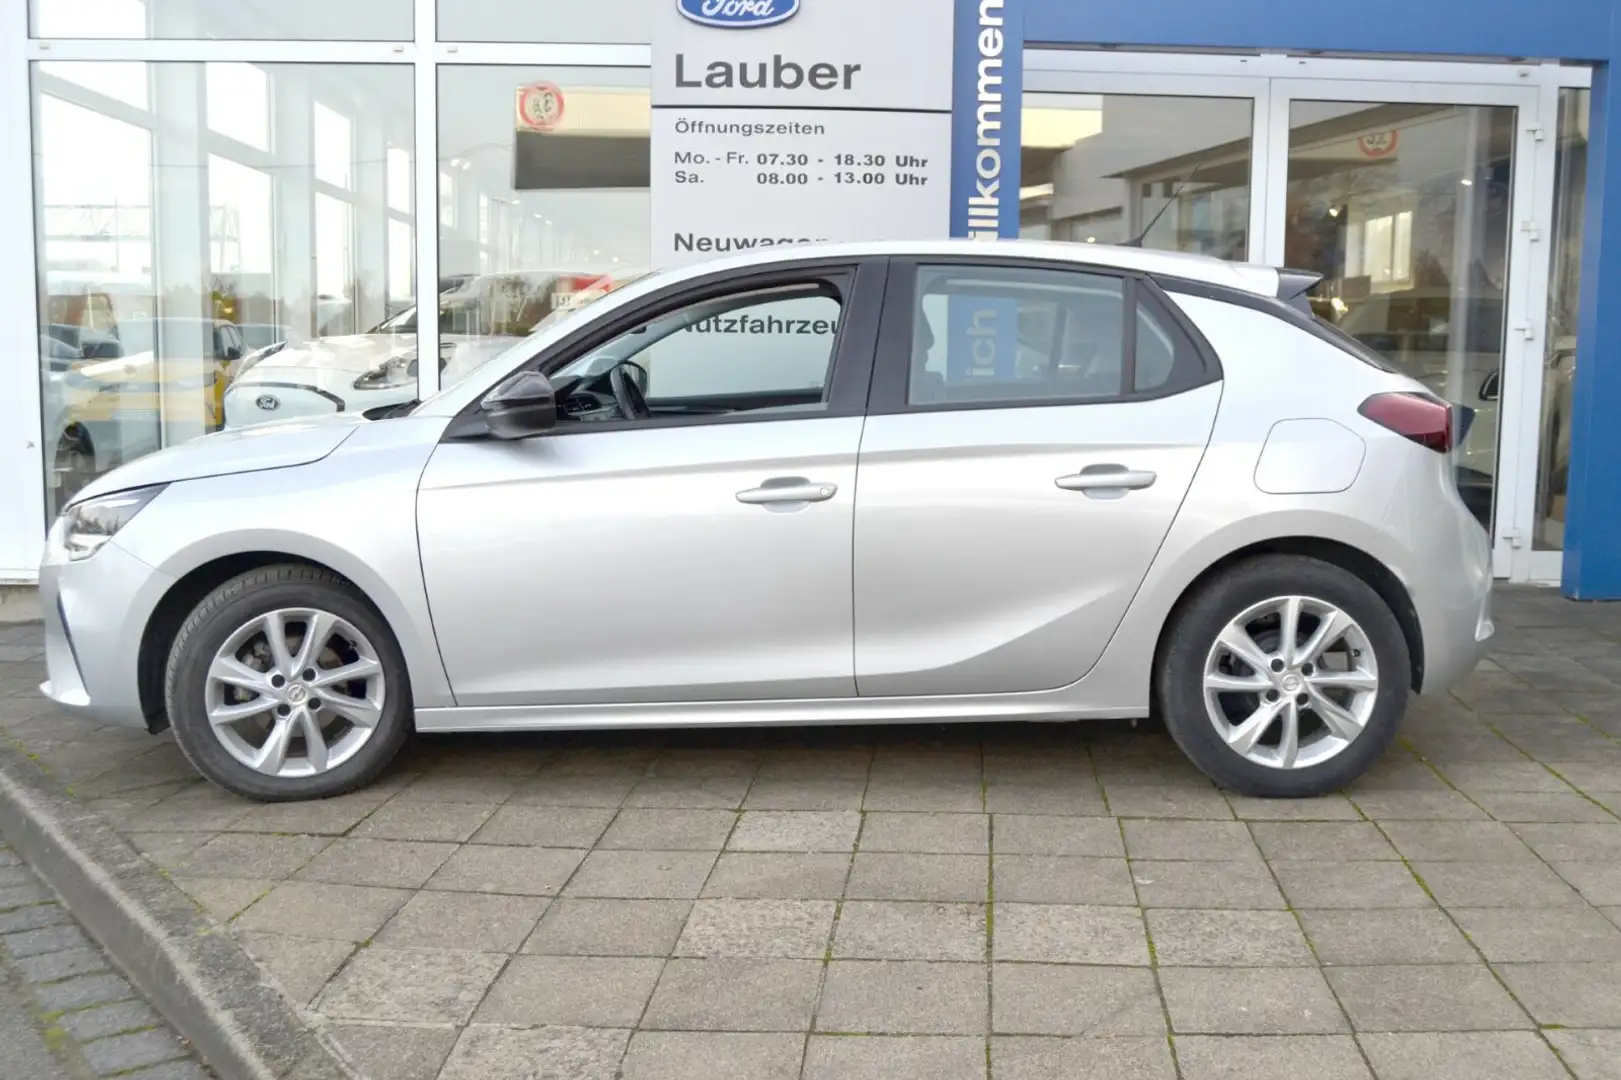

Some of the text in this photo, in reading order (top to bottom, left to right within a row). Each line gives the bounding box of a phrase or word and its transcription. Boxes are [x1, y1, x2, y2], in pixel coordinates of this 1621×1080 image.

[675, 53, 862, 91] Lauber
[674, 117, 826, 137] Öffnungszeiten
[966, 0, 1004, 239] illkommen
[674, 151, 710, 165] Mo.
[726, 151, 750, 165] Fr.
[756, 152, 809, 166] 07.30
[833, 153, 886, 167] 18.30
[895, 155, 929, 169] Uhr
[674, 170, 705, 184] Sa.
[756, 172, 809, 186] 08.00
[833, 172, 886, 187] 13.00
[895, 172, 929, 187] Uhr
[965, 309, 997, 377] ich
